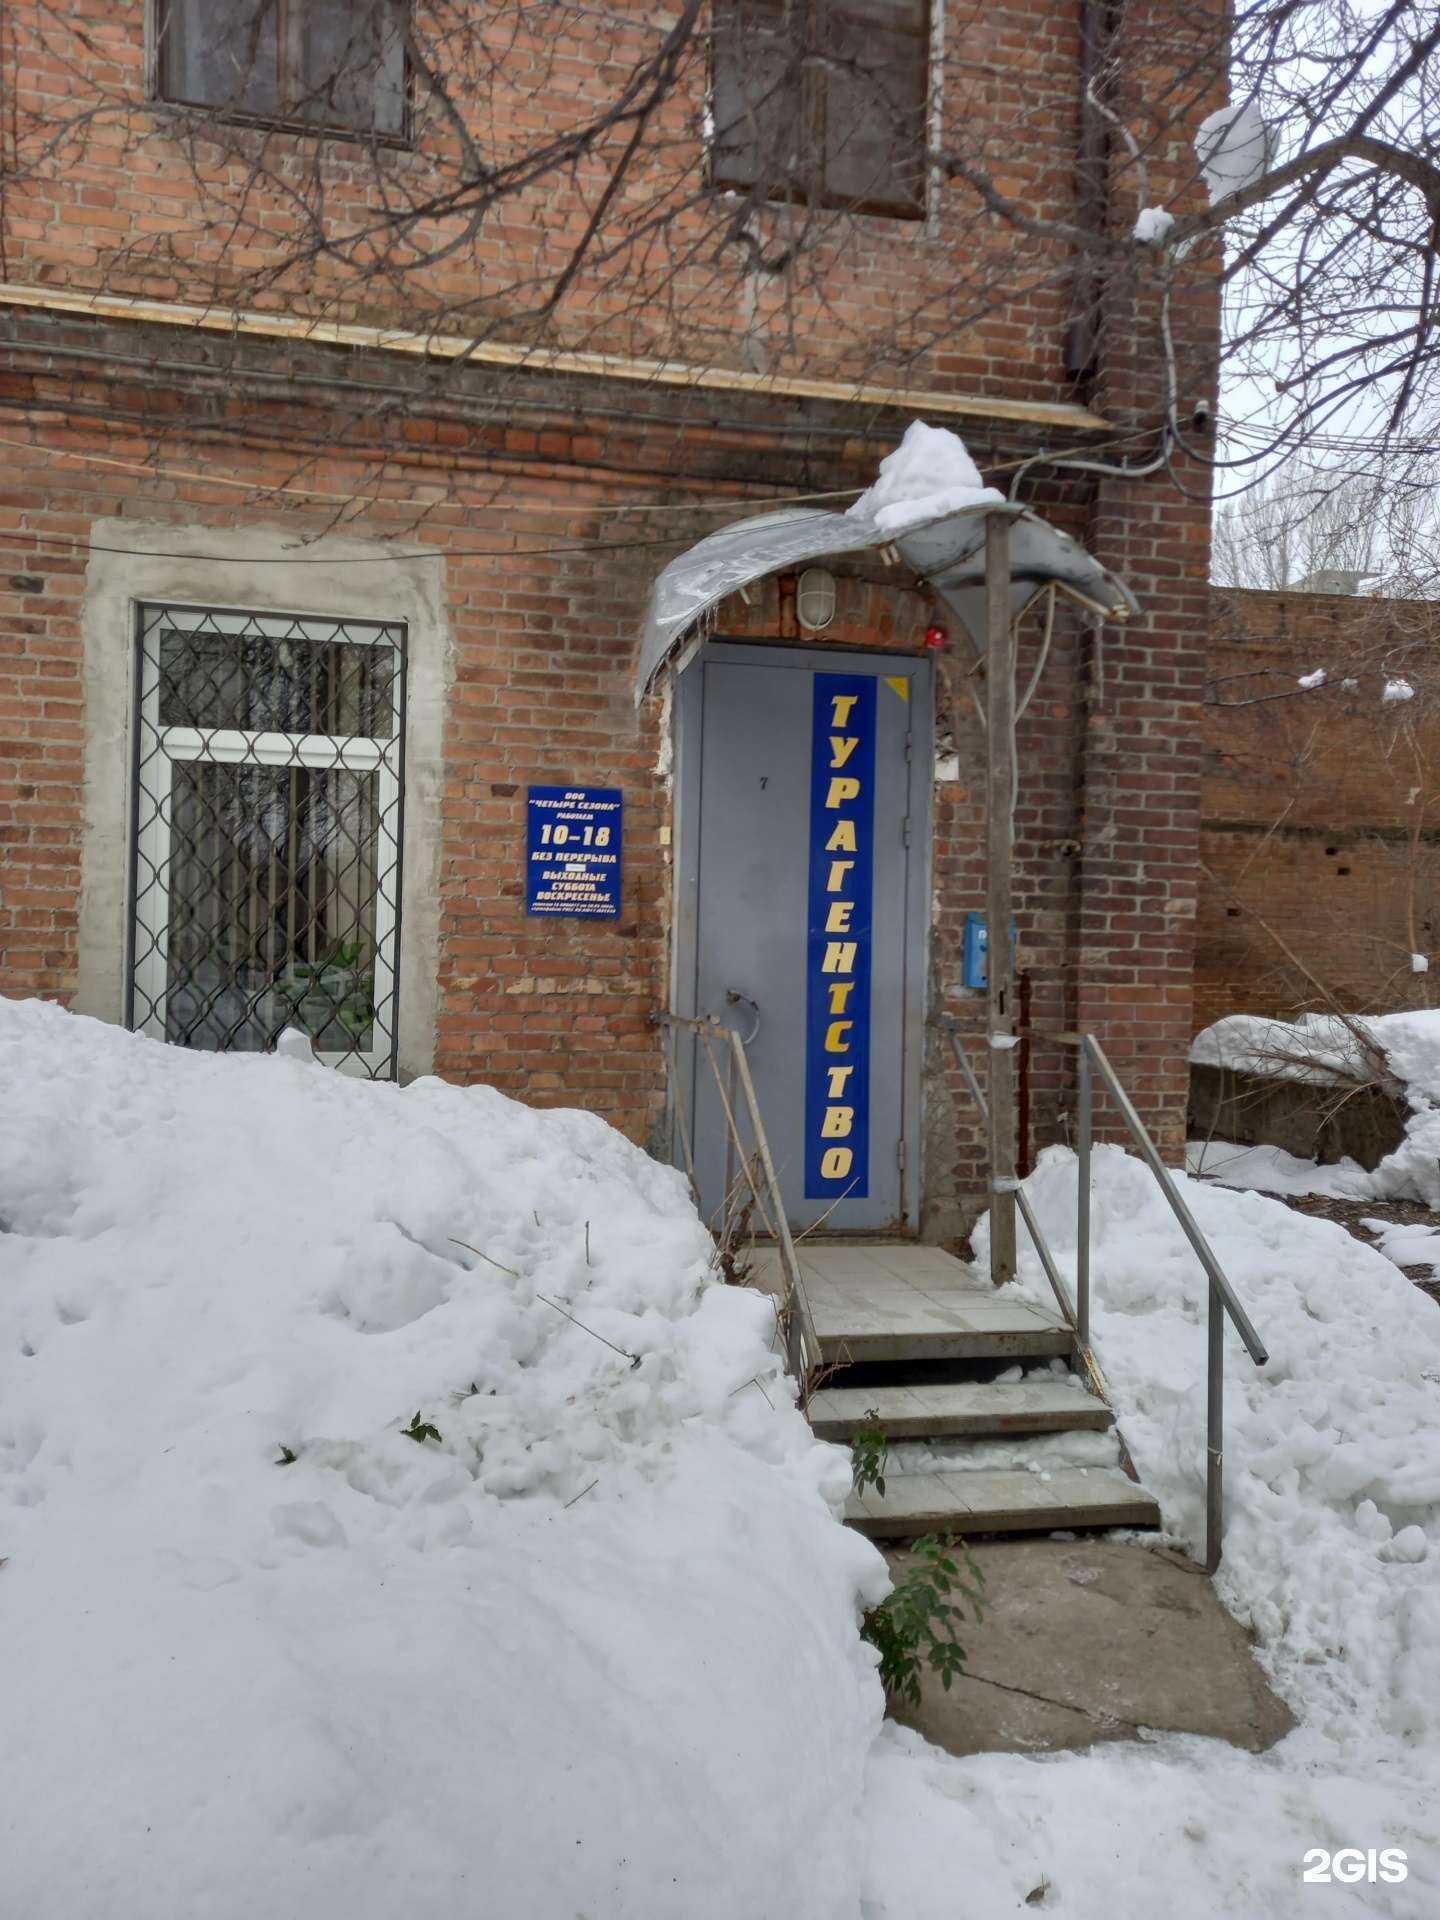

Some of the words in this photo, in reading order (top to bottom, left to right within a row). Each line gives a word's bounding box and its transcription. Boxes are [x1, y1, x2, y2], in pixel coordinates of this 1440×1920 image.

[564, 792, 585, 800] ООО
[529, 799, 575, 809] "ЧЕТЫРЕ
[577, 802, 620, 811] СЕЗОНА"
[541, 824, 610, 846] 10-18
[531, 851, 552, 862] БЕЗ
[555, 852, 616, 863] ПЕРЕРЫВА
[542, 870, 606, 882] ВЫХОДНЫЕ
[552, 882, 595, 891] СУББОТА
[536, 891, 610, 902] ВОСКРЕСЕНЬЕ
[820, 695, 861, 1180] ТУРАГЕНТСТВО
